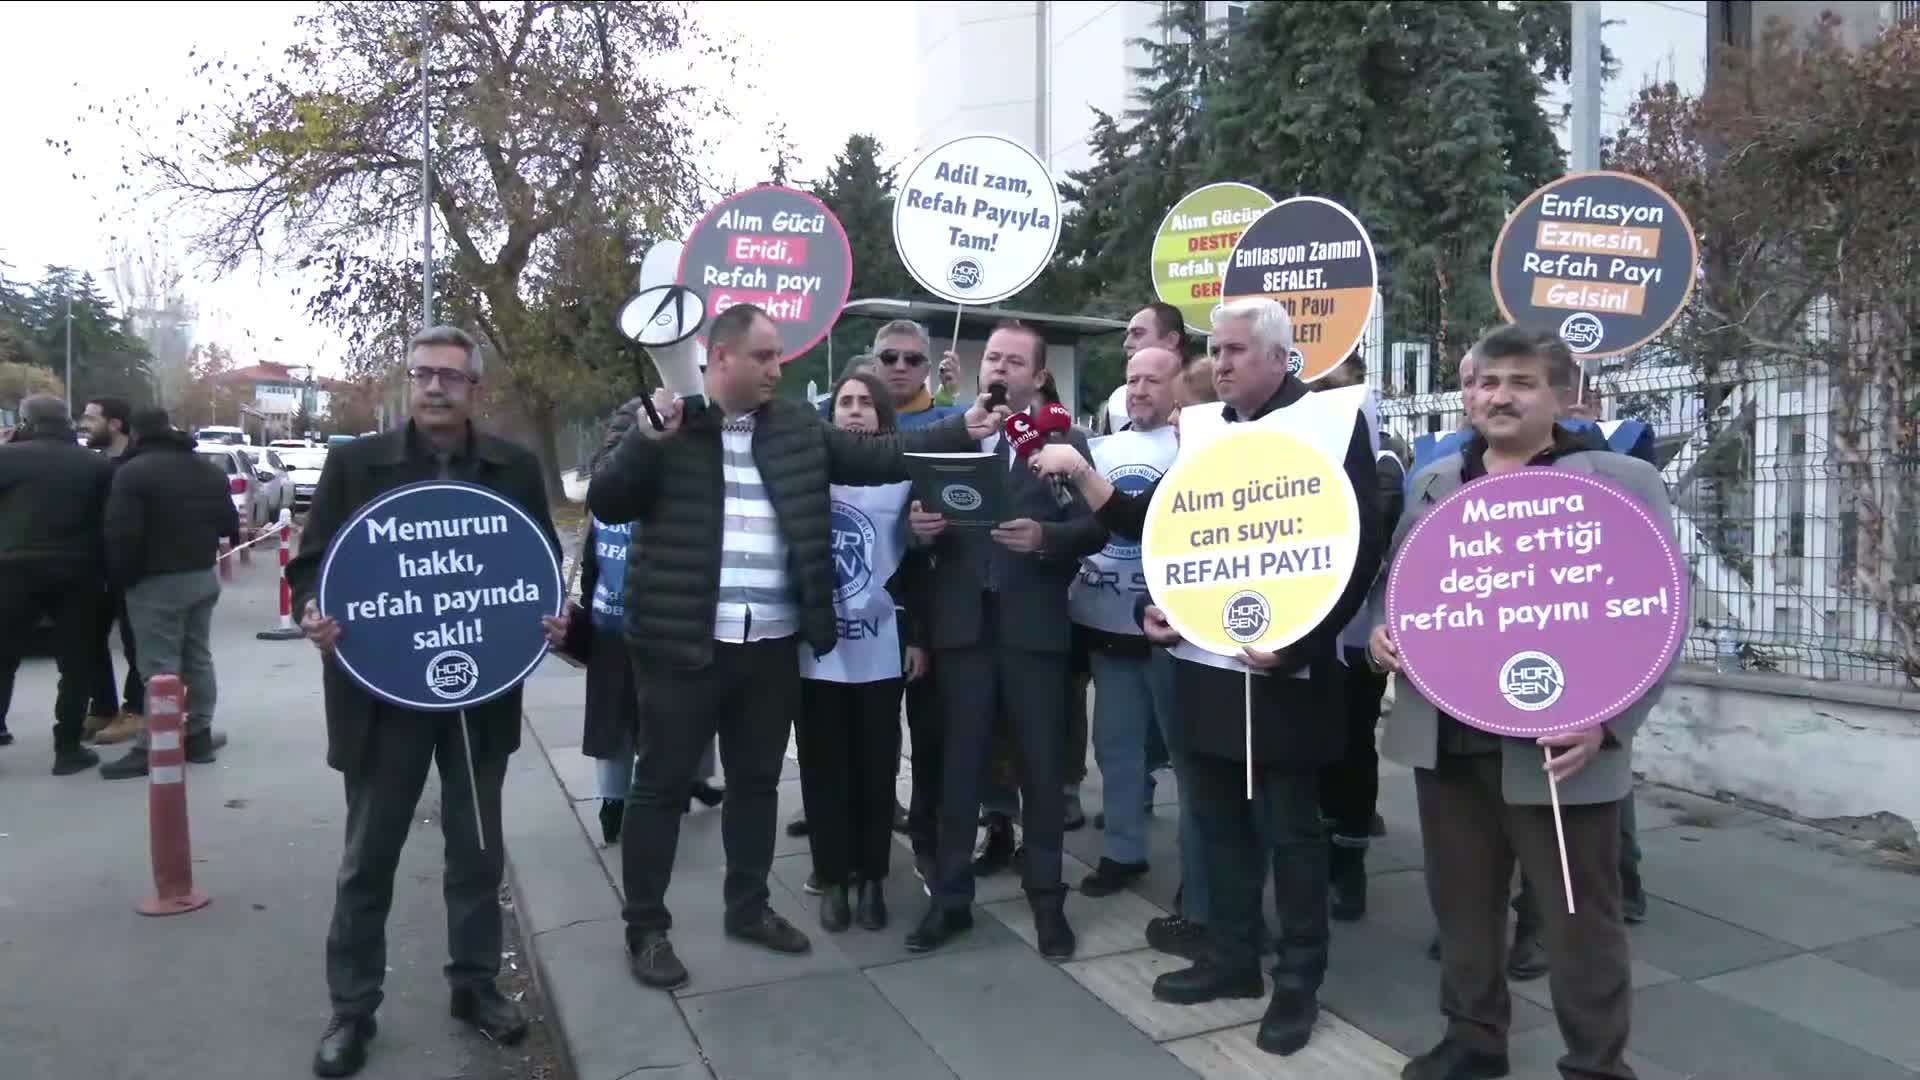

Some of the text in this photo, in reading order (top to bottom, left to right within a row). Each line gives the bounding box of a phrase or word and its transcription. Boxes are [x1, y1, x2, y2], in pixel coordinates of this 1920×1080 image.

[934, 161, 1033, 198] Adil zam,
[716, 210, 825, 233] Alım Gücü
[906, 188, 1050, 231] Refah Payıyla
[1171, 207, 1266, 231] Alım Gücün
[1541, 193, 1664, 226] Enflasyon
[735, 238, 793, 264] Eridi,
[949, 226, 999, 252] Tam!
[1188, 231, 1241, 252] DESTE
[1236, 240, 1362, 268] Enflasyon Zammı
[1540, 225, 1650, 255] Ezmesin,
[703, 265, 821, 296] Refah payı
[1168, 259, 1214, 278] Refah
[1523, 253, 1662, 288] Refah Payı
[1191, 281, 1222, 298] GER
[1546, 284, 1629, 310] Gelsin!
[714, 294, 802, 319] Gkti!
[1302, 297, 1335, 317] Payı
[1292, 324, 1321, 344] LET!
[1171, 475, 1321, 513] Alım gücüne
[1462, 494, 1585, 524] Memura
[366, 514, 508, 544] Memurun
[1190, 516, 1303, 548] can suyu:
[1450, 521, 1602, 558] hak ettiği
[399, 549, 484, 578] hakkı,
[1165, 554, 1250, 586] REFAH
[1260, 545, 1332, 576] PAYI!
[1440, 563, 1614, 598] değeri ver,
[347, 579, 540, 620] refah payında
[1606, 587, 1668, 618] ser!
[1400, 600, 1589, 632] refah payını
[413, 619, 483, 650] saklı!
